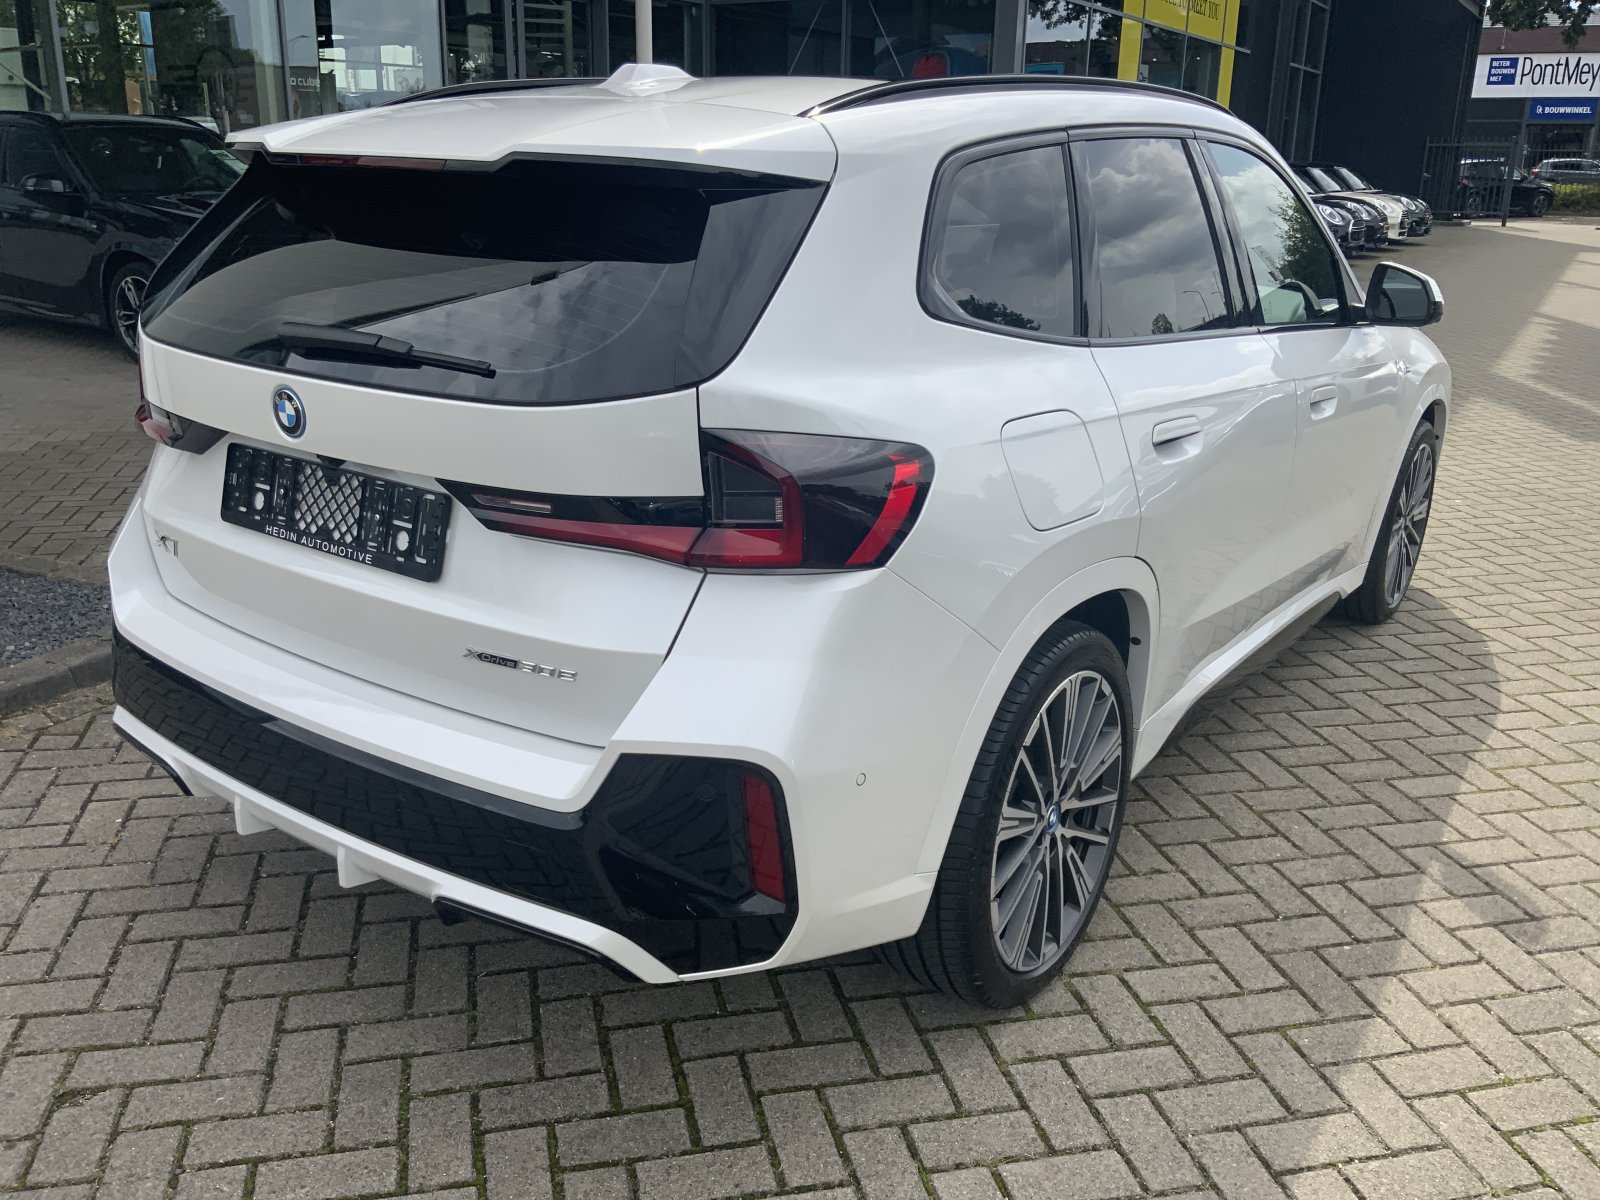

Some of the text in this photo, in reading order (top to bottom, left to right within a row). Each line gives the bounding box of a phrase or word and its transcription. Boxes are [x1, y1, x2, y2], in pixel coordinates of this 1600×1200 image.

[1190, 0, 1208, 16] MEET
[1208, 1, 1221, 20] YOU
[298, 76, 320, 87] cube
[265, 525, 373, 564] HEDIN AUTOMOTIVE
